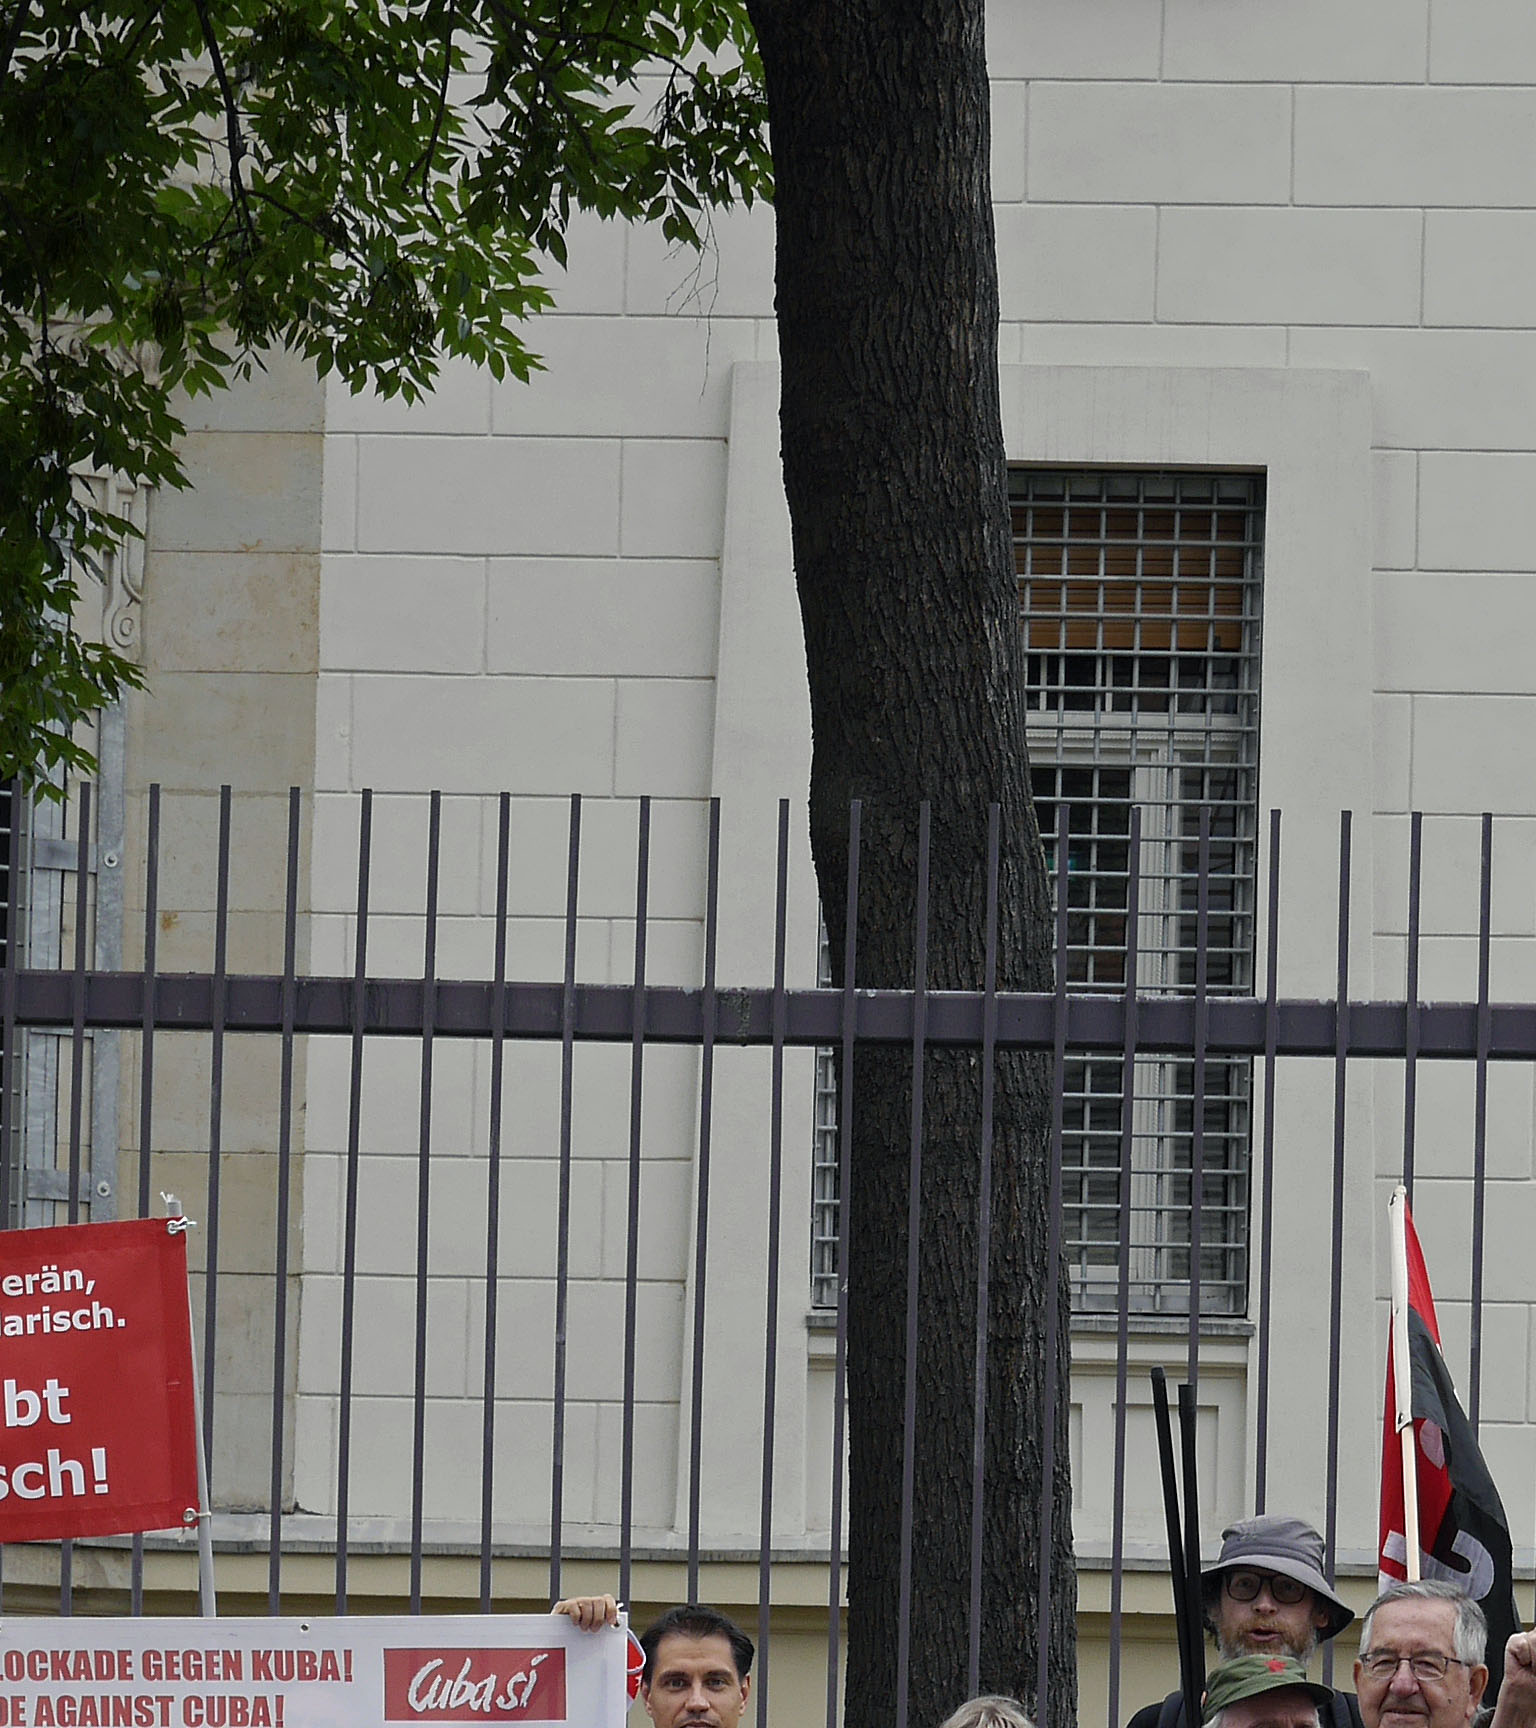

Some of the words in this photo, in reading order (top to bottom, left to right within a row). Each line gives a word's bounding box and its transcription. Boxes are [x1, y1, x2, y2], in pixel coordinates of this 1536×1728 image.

[142, 1649, 247, 1682] GEGEN
[251, 1649, 354, 1682] KUBA!
[33, 1695, 175, 1728] AGAINST
[183, 1695, 284, 1728] CUBA!
